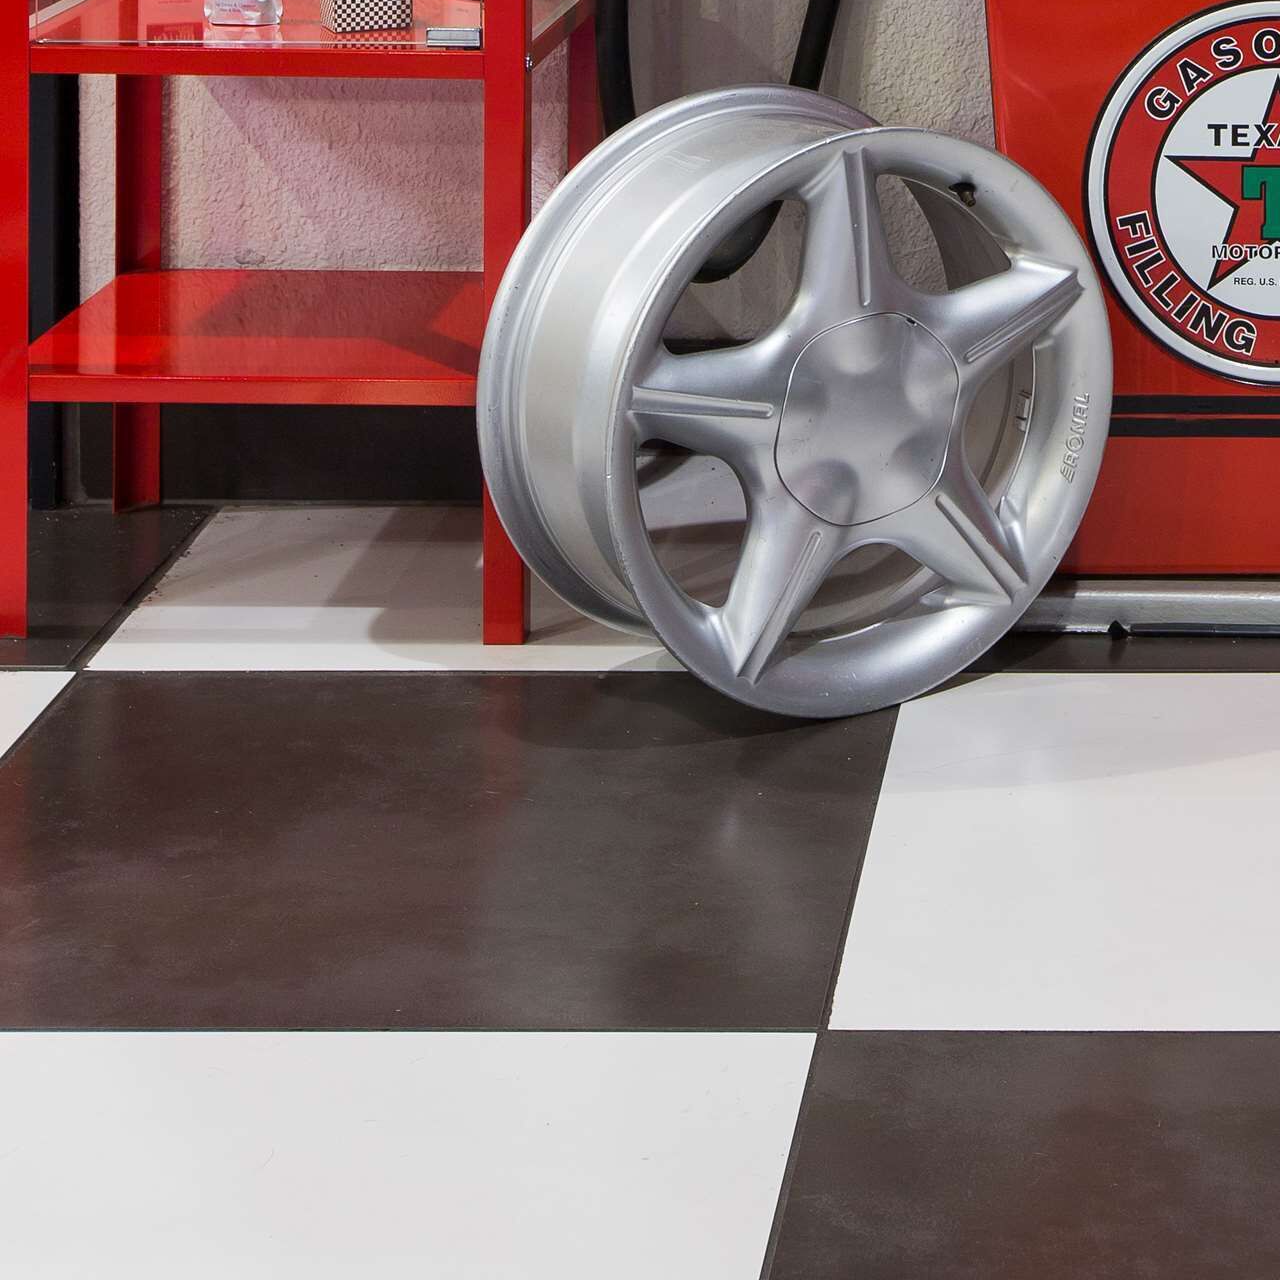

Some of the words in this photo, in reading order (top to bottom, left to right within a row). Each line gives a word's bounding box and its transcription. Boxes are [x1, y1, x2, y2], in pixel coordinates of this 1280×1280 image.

[1116, 209, 1258, 356] FILLING
[1233, 277, 1257, 286] REG.
[1259, 277, 1278, 286] U.S.
